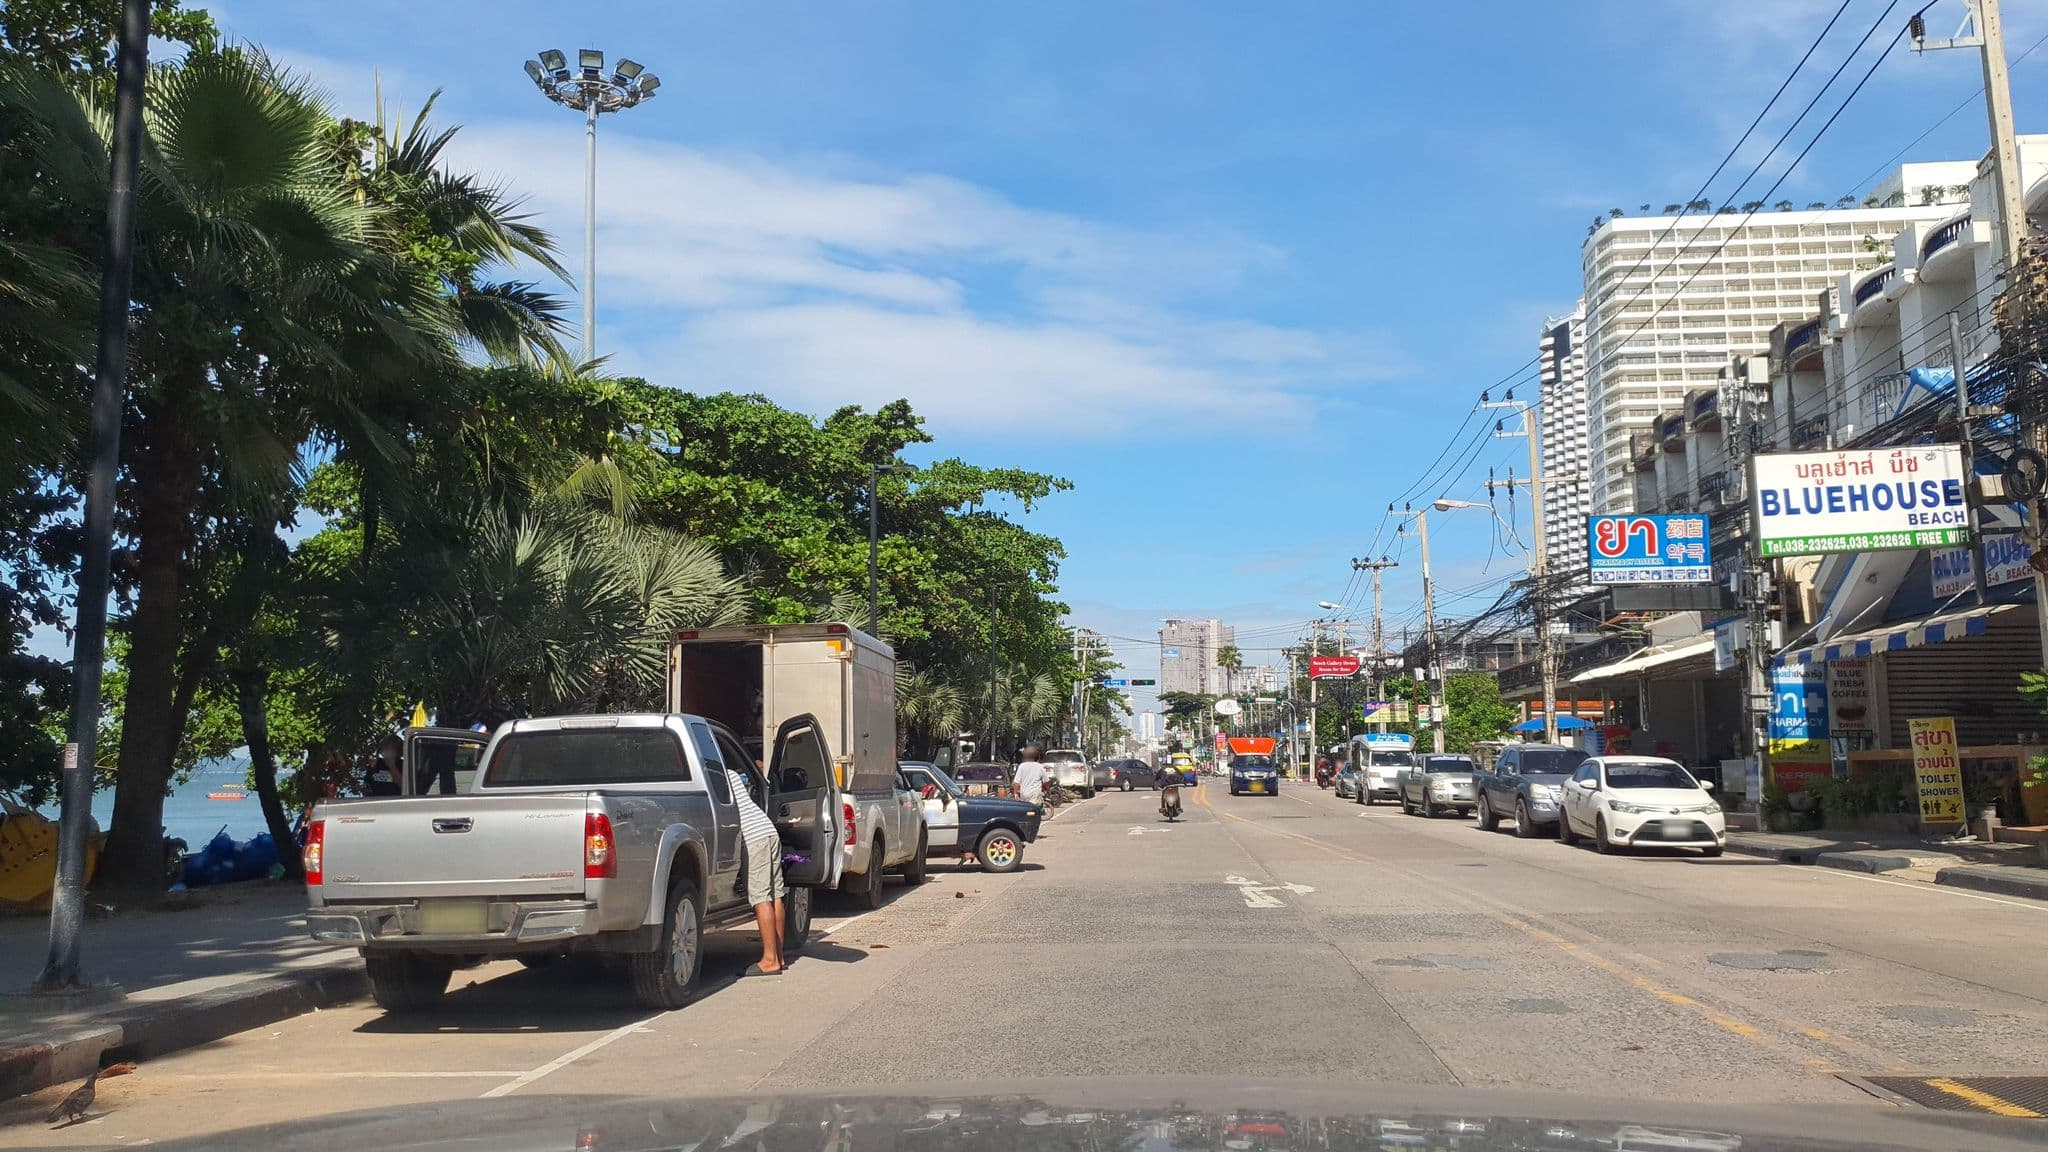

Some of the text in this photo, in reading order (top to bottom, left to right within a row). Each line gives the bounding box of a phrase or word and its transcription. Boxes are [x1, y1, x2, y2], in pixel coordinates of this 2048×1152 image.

[1795, 449, 1918, 485] บลูเฮ้าส์ บีช
[1760, 478, 1963, 517] BLUEHOUSE
[1908, 511, 1965, 526] BEACH
[1595, 518, 1659, 558] ยา
[1915, 531, 1943, 545] FREE
[1666, 542, 1705, 563] 약국
[1834, 680, 1865, 688] FRESH
[1832, 690, 1868, 698] COFFEE
[1914, 730, 1952, 751] สุขา
[1917, 748, 1955, 769] อาบน้ำ
[1920, 774, 1956, 784] TOILET
[1920, 787, 1959, 797] SHOWER
